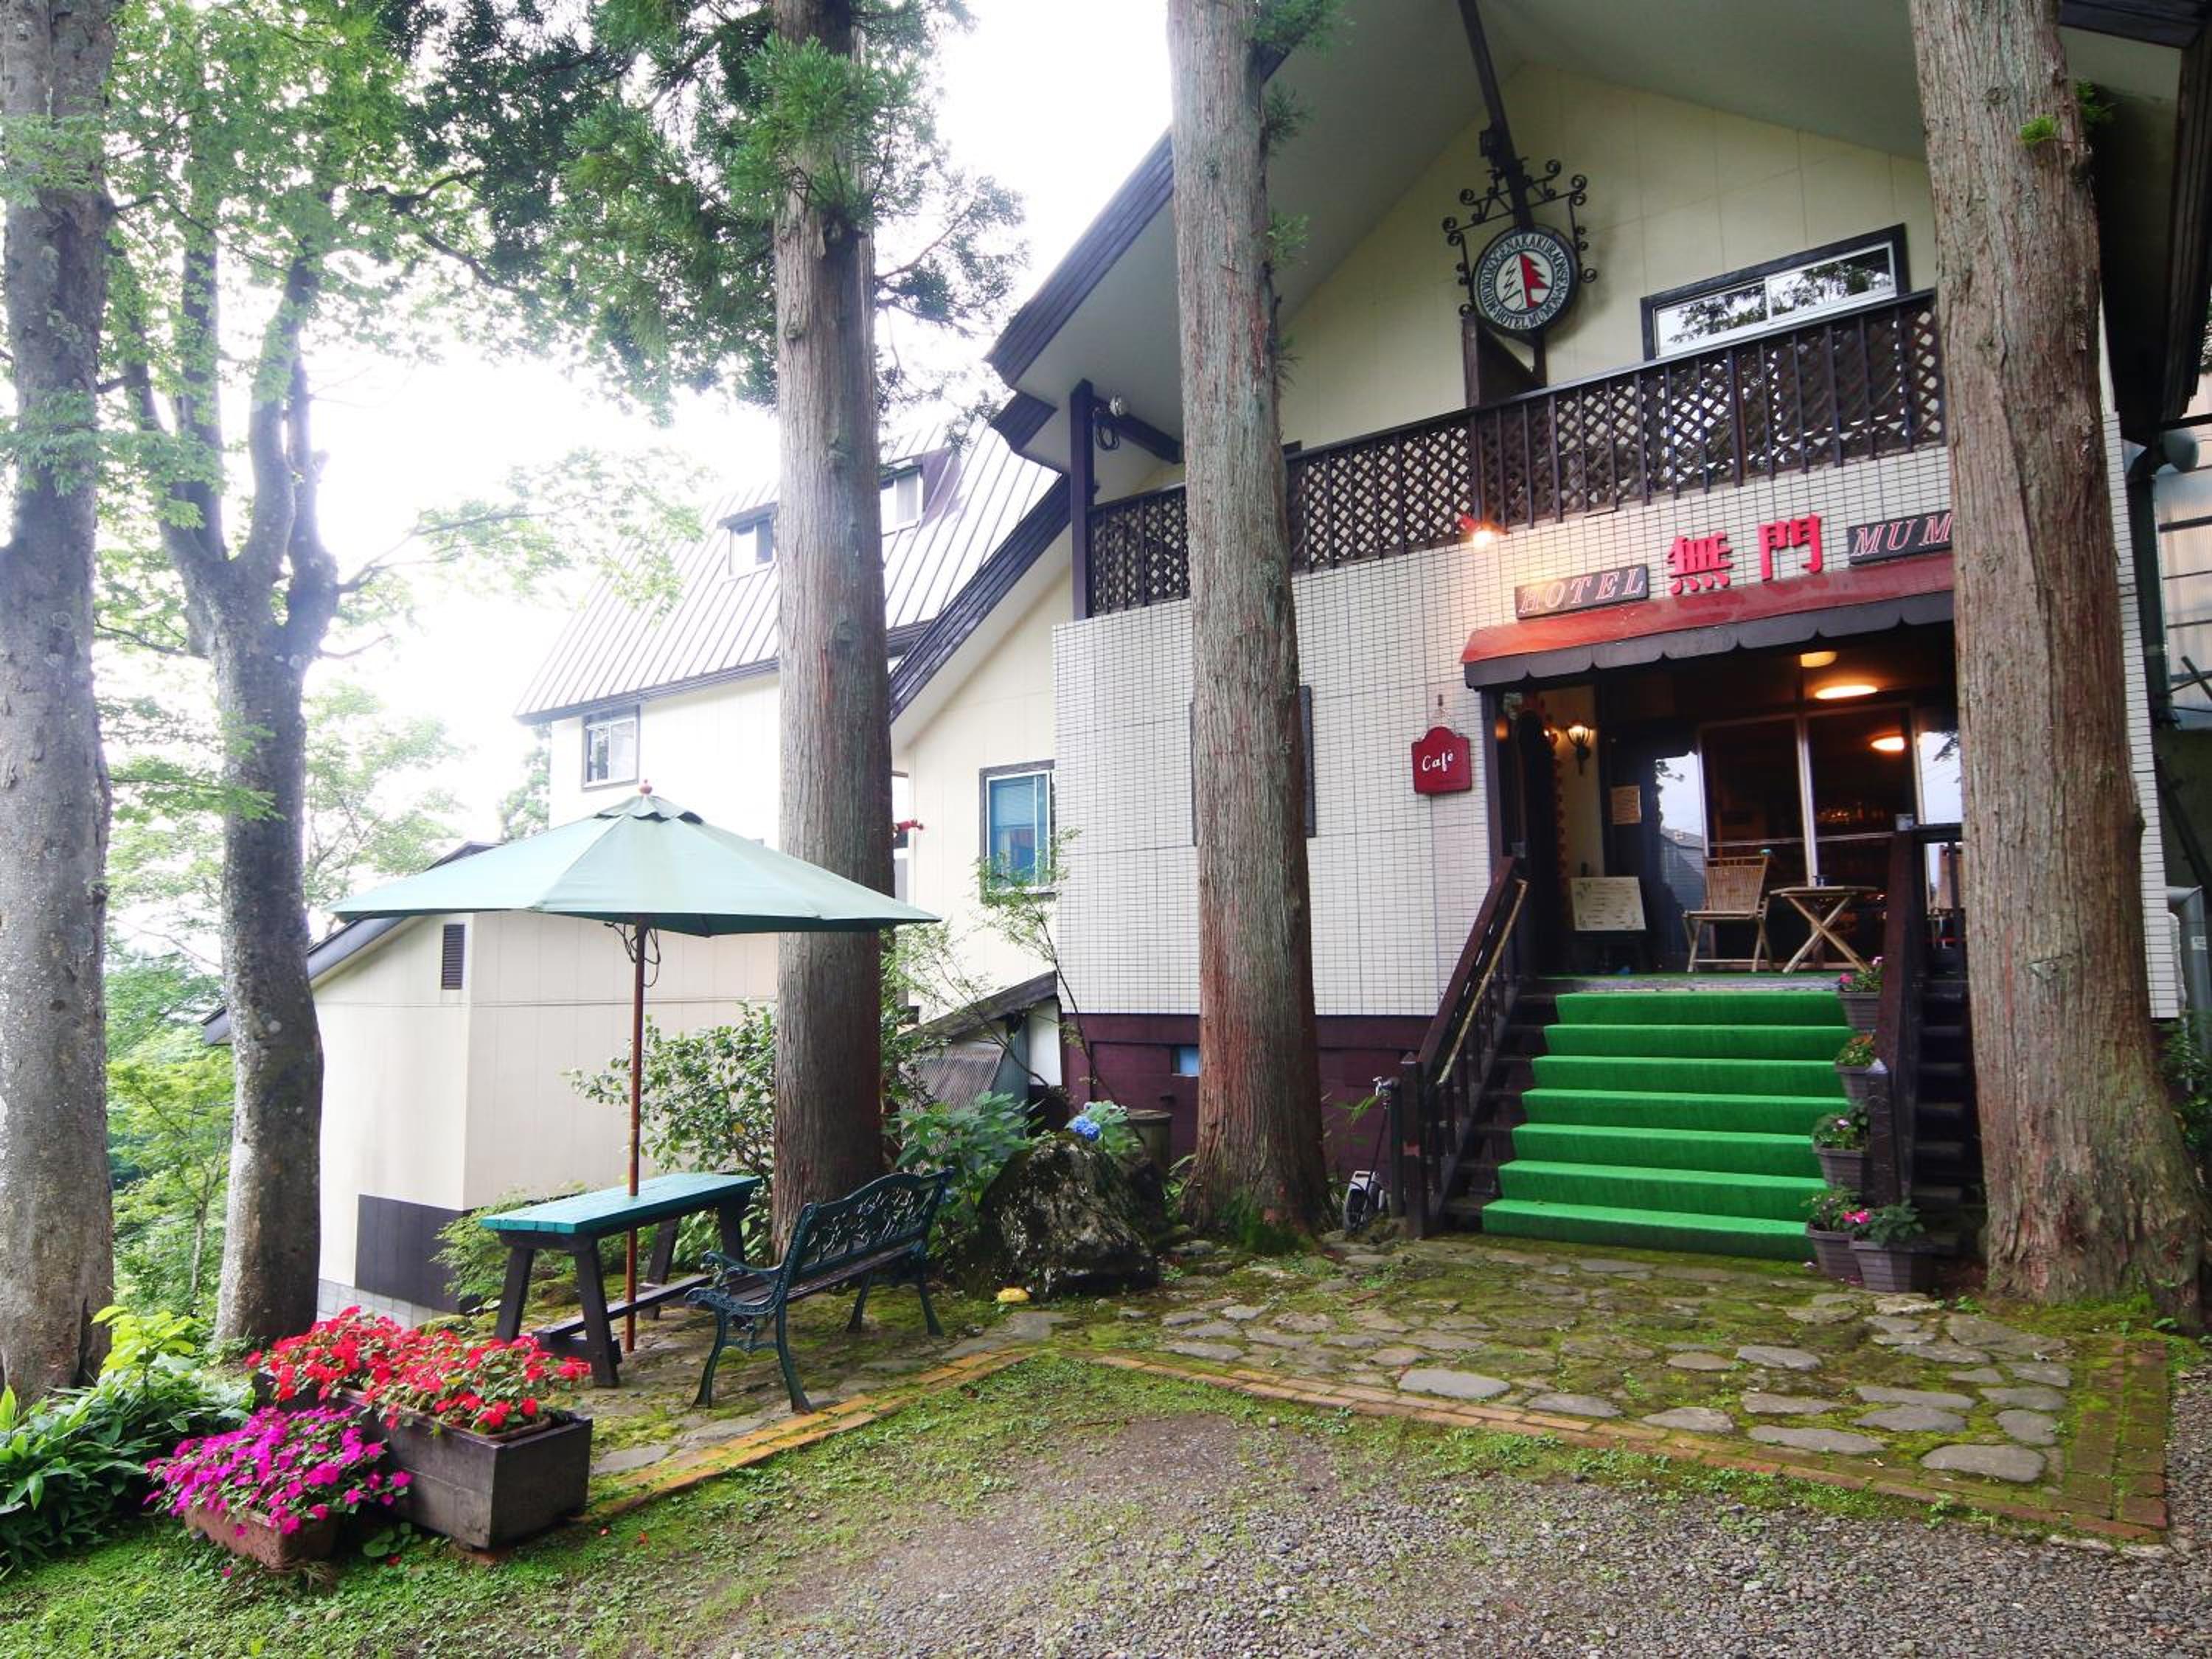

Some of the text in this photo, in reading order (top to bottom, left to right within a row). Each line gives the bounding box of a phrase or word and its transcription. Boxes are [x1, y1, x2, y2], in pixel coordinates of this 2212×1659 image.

[1493, 310, 1528, 329] HOTEL
[1667, 512, 1823, 595] 無門
[1519, 568, 1644, 613] HOTEL
